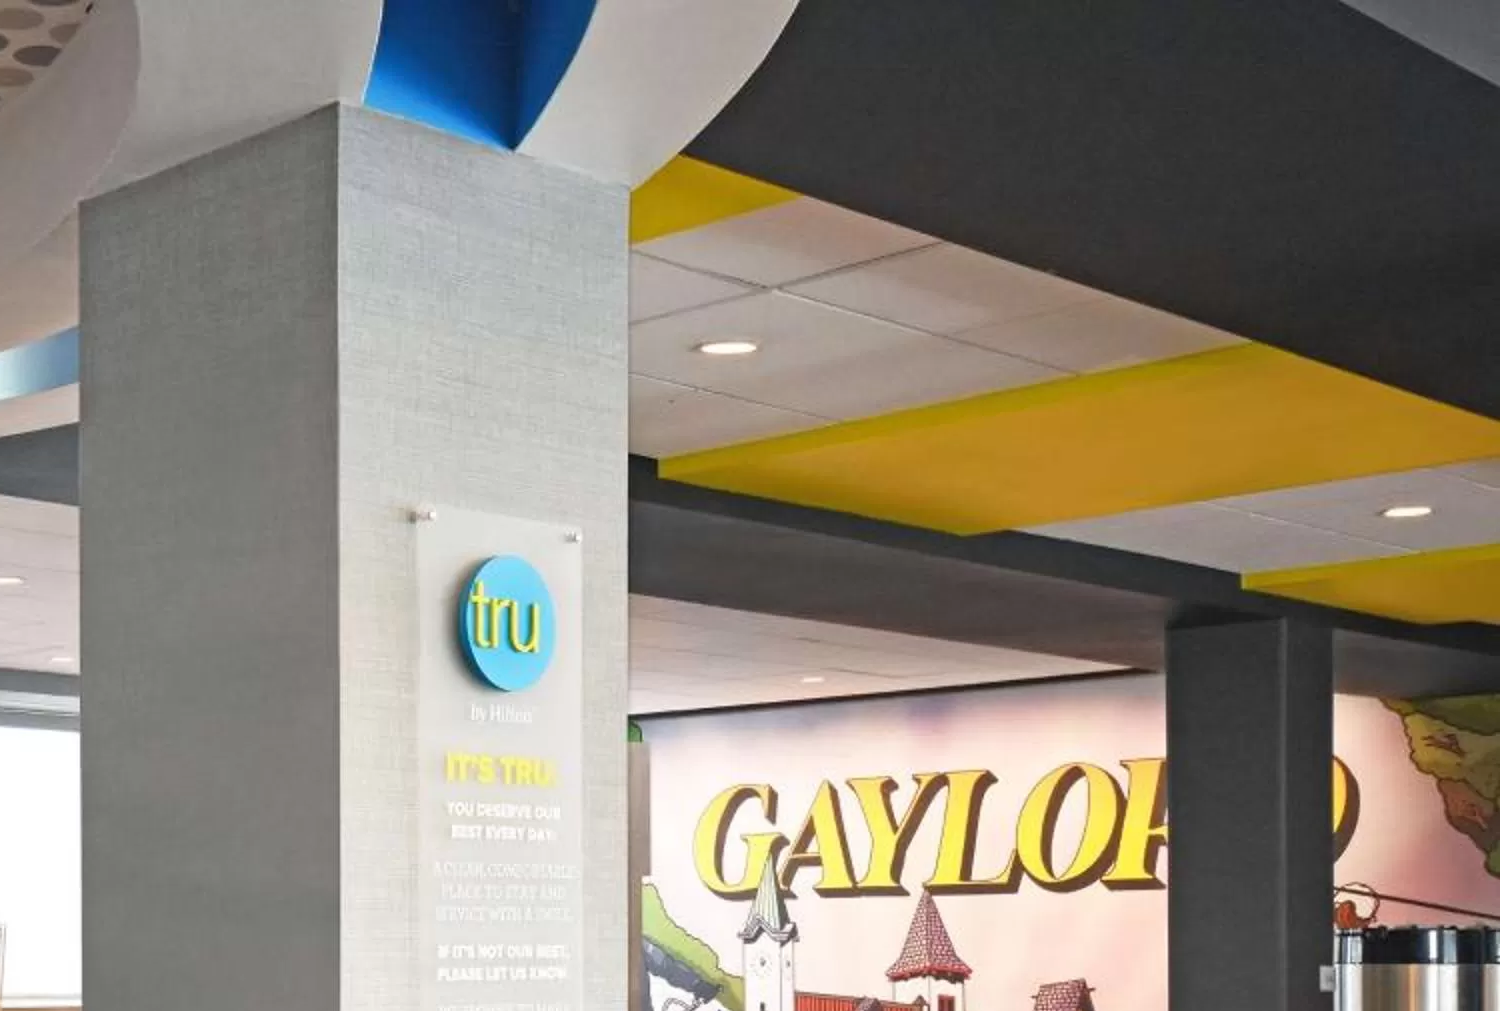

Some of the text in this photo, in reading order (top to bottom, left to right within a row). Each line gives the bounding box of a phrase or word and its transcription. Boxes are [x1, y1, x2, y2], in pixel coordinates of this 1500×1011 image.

[470, 579, 540, 653] tru
[471, 702, 488, 724] by
[445, 750, 494, 784] IT'S
[446, 801, 561, 820] YOU DESERVE OUR
[451, 824, 482, 840] BEST
[485, 825, 524, 841] EVERY
[477, 944, 504, 959] NOT
[507, 944, 533, 959] OUR
[437, 967, 484, 982] PLEASE
[485, 966, 507, 982] LET
[509, 967, 527, 982] US
